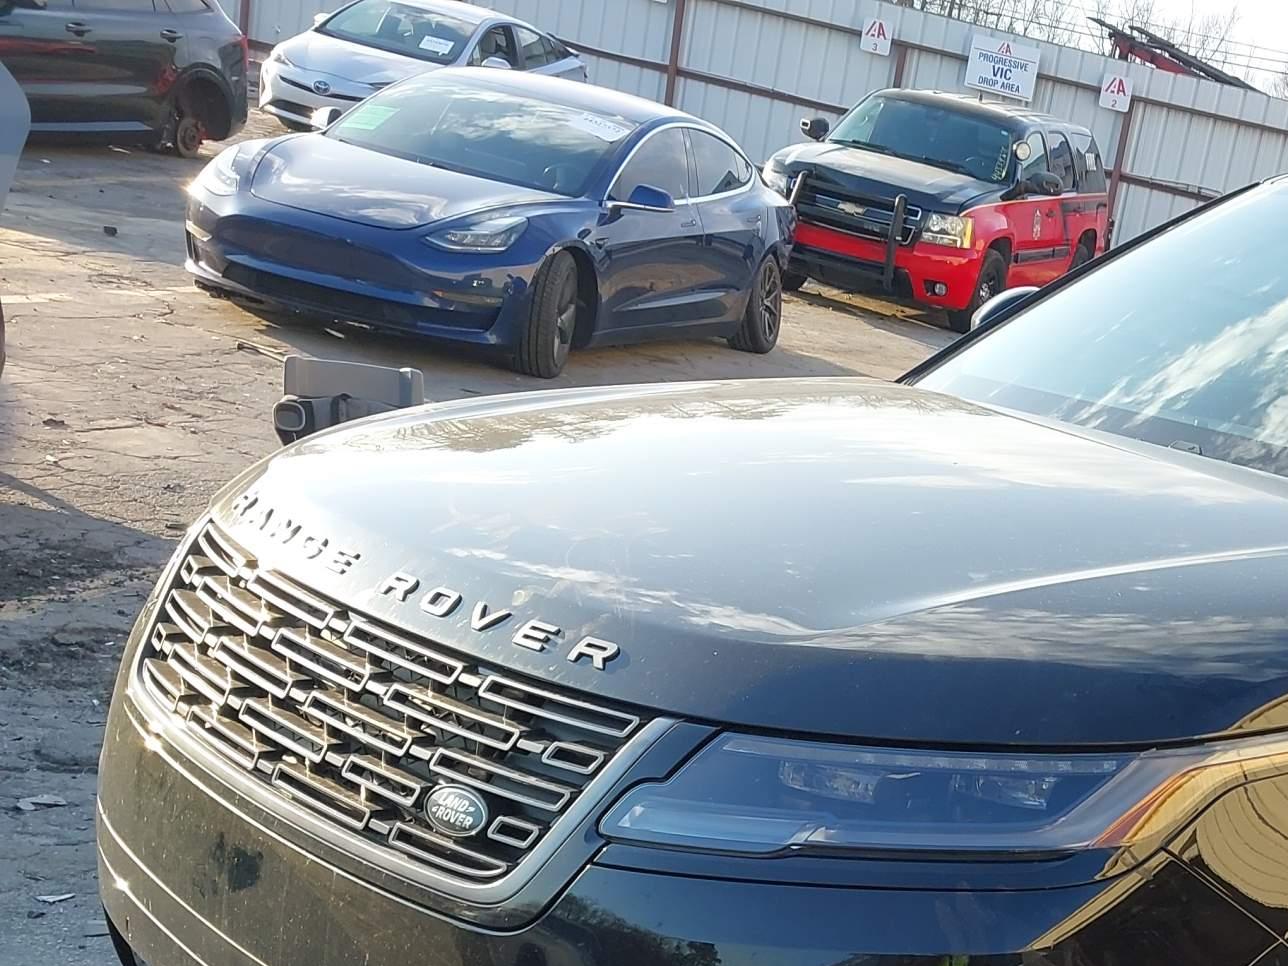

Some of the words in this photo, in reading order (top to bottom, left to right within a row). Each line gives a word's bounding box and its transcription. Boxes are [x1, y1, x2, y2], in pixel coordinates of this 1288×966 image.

[871, 42, 878, 52] 3
[978, 52, 1030, 73] PROGRESSIVE
[991, 65, 1013, 81] VIC
[977, 75, 1000, 88] DROP
[999, 80, 1021, 94] AREA
[1111, 99, 1118, 108] 2
[379, 570, 622, 672] ROVER
[437, 790, 471, 816] LAND
[437, 806, 475, 831] ROVER
